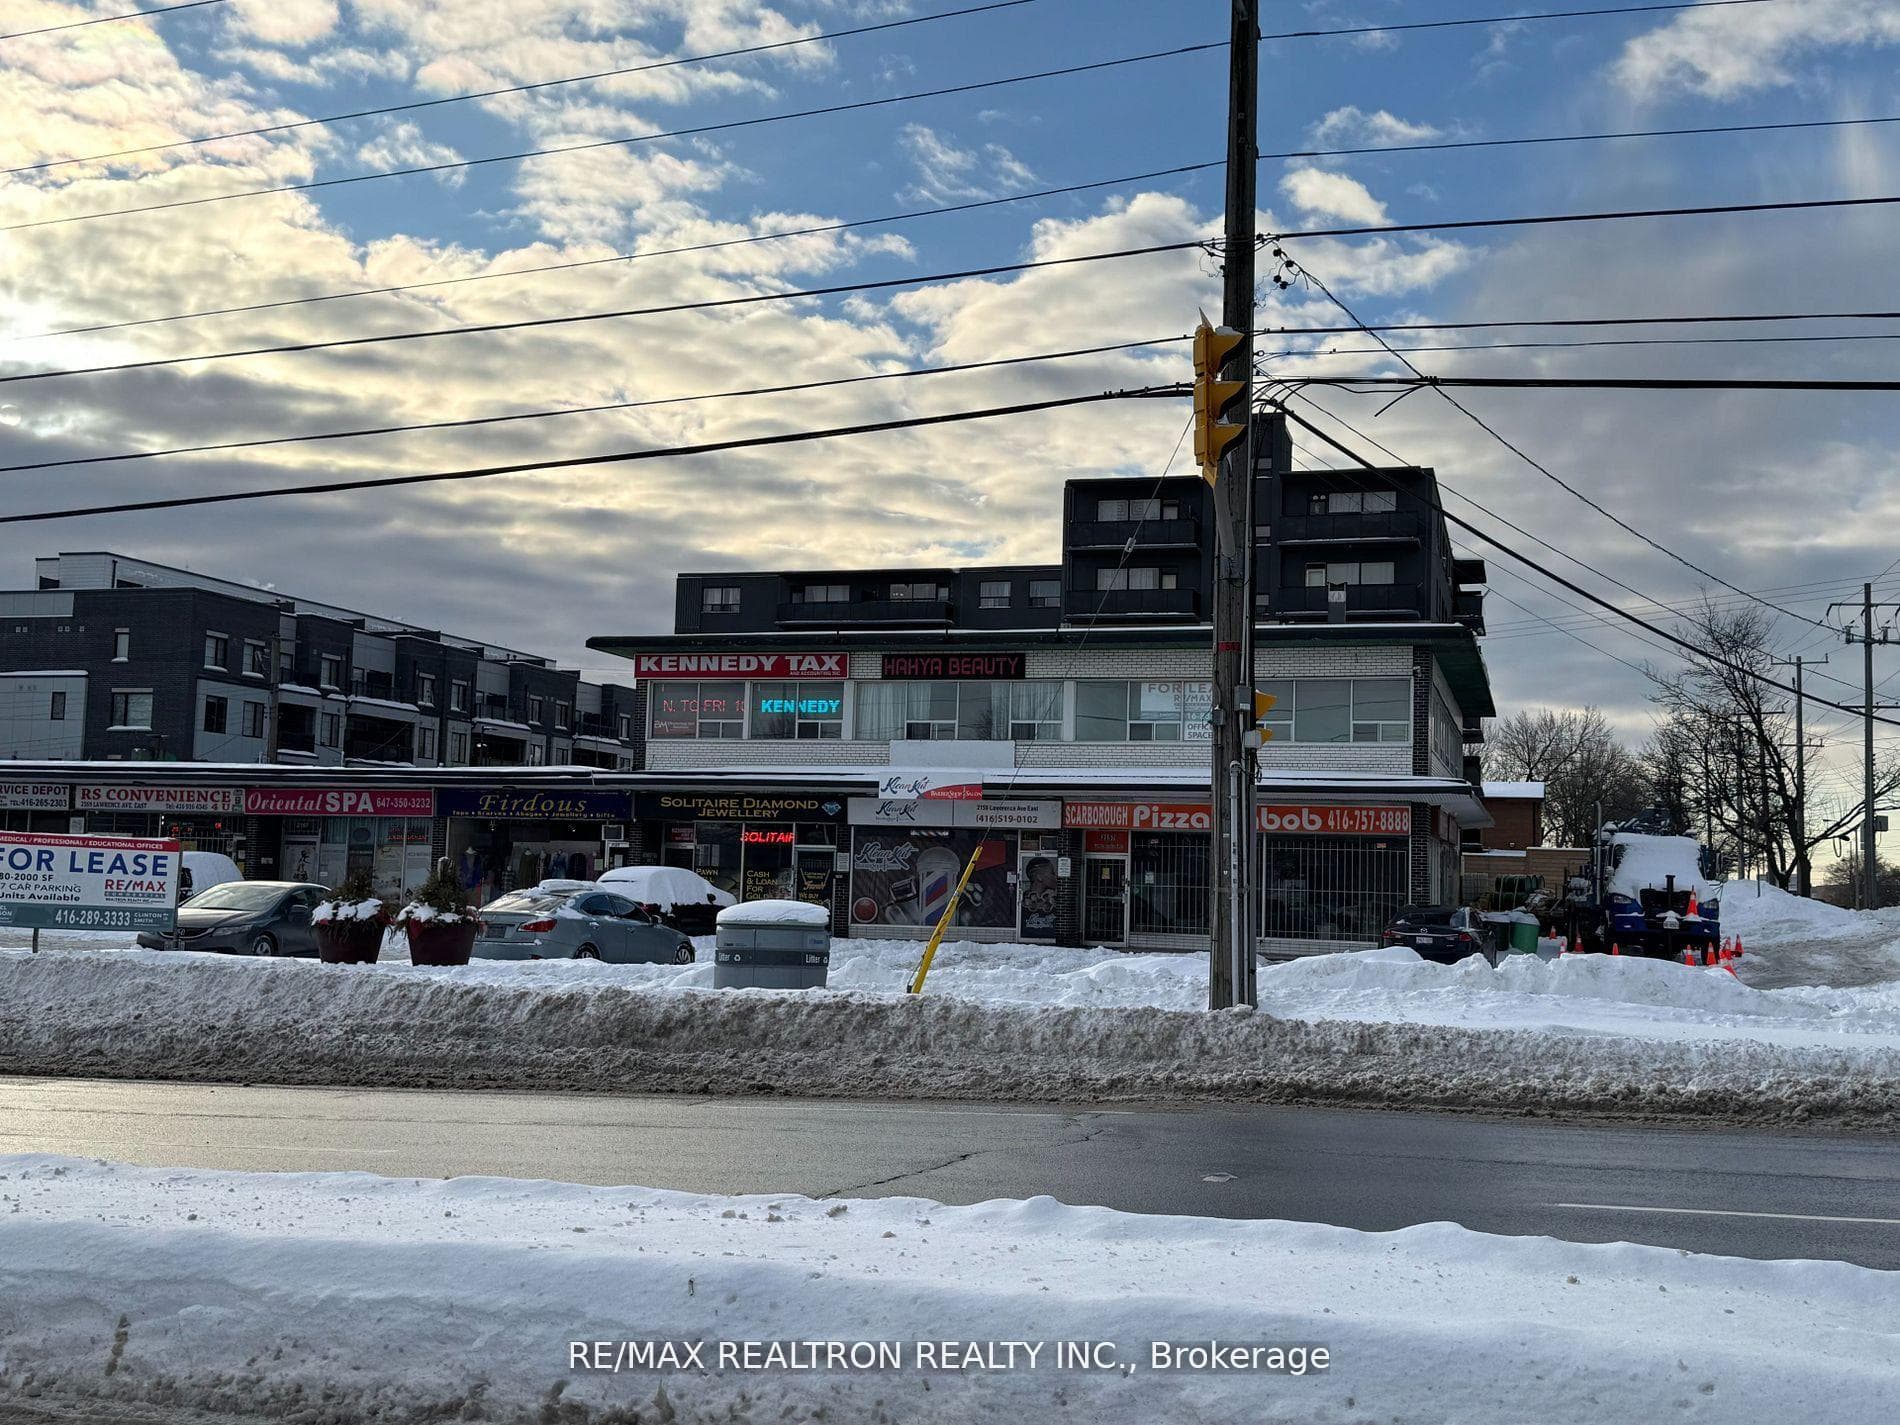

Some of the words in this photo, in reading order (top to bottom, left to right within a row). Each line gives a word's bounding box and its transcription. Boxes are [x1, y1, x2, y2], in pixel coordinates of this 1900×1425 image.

[641, 656, 779, 672] KENNEDY
[785, 656, 841, 671] TAX
[948, 657, 1019, 675] BEAUTY
[1148, 683, 1182, 693] FOR
[1188, 683, 1213, 693] LE
[703, 700, 726, 712] FRI
[761, 699, 841, 713] KENNEDY
[1187, 731, 1213, 739] SPACE
[32, 786, 68, 796] DEPOT
[81, 788, 101, 800] RS
[106, 788, 231, 803] CONVENIENCE
[247, 791, 323, 811] Oriental
[326, 791, 374, 813] SPA
[376, 797, 431, 808] 647-350-3232
[479, 792, 587, 812] Firdous
[697, 807, 780, 818] JEWELLERY
[976, 814, 1038, 824] (416)519-0102
[1065, 805, 1128, 826] SCARBOROUGH
[1133, 805, 1210, 829] Pizza
[1256, 807, 1322, 831] bob
[1328, 809, 1409, 831] 416-757-8888
[33, 837, 83, 846] PROFESSIONAL
[88, 840, 135, 848] EDUCATIONAL
[69, 850, 168, 877] LEASE
[9, 883, 31, 891] CAR
[34, 884, 81, 893] PARKING
[105, 879, 167, 892] RE/MAX
[28, 893, 80, 902] Available
[55, 909, 131, 926] 416-289-3333
